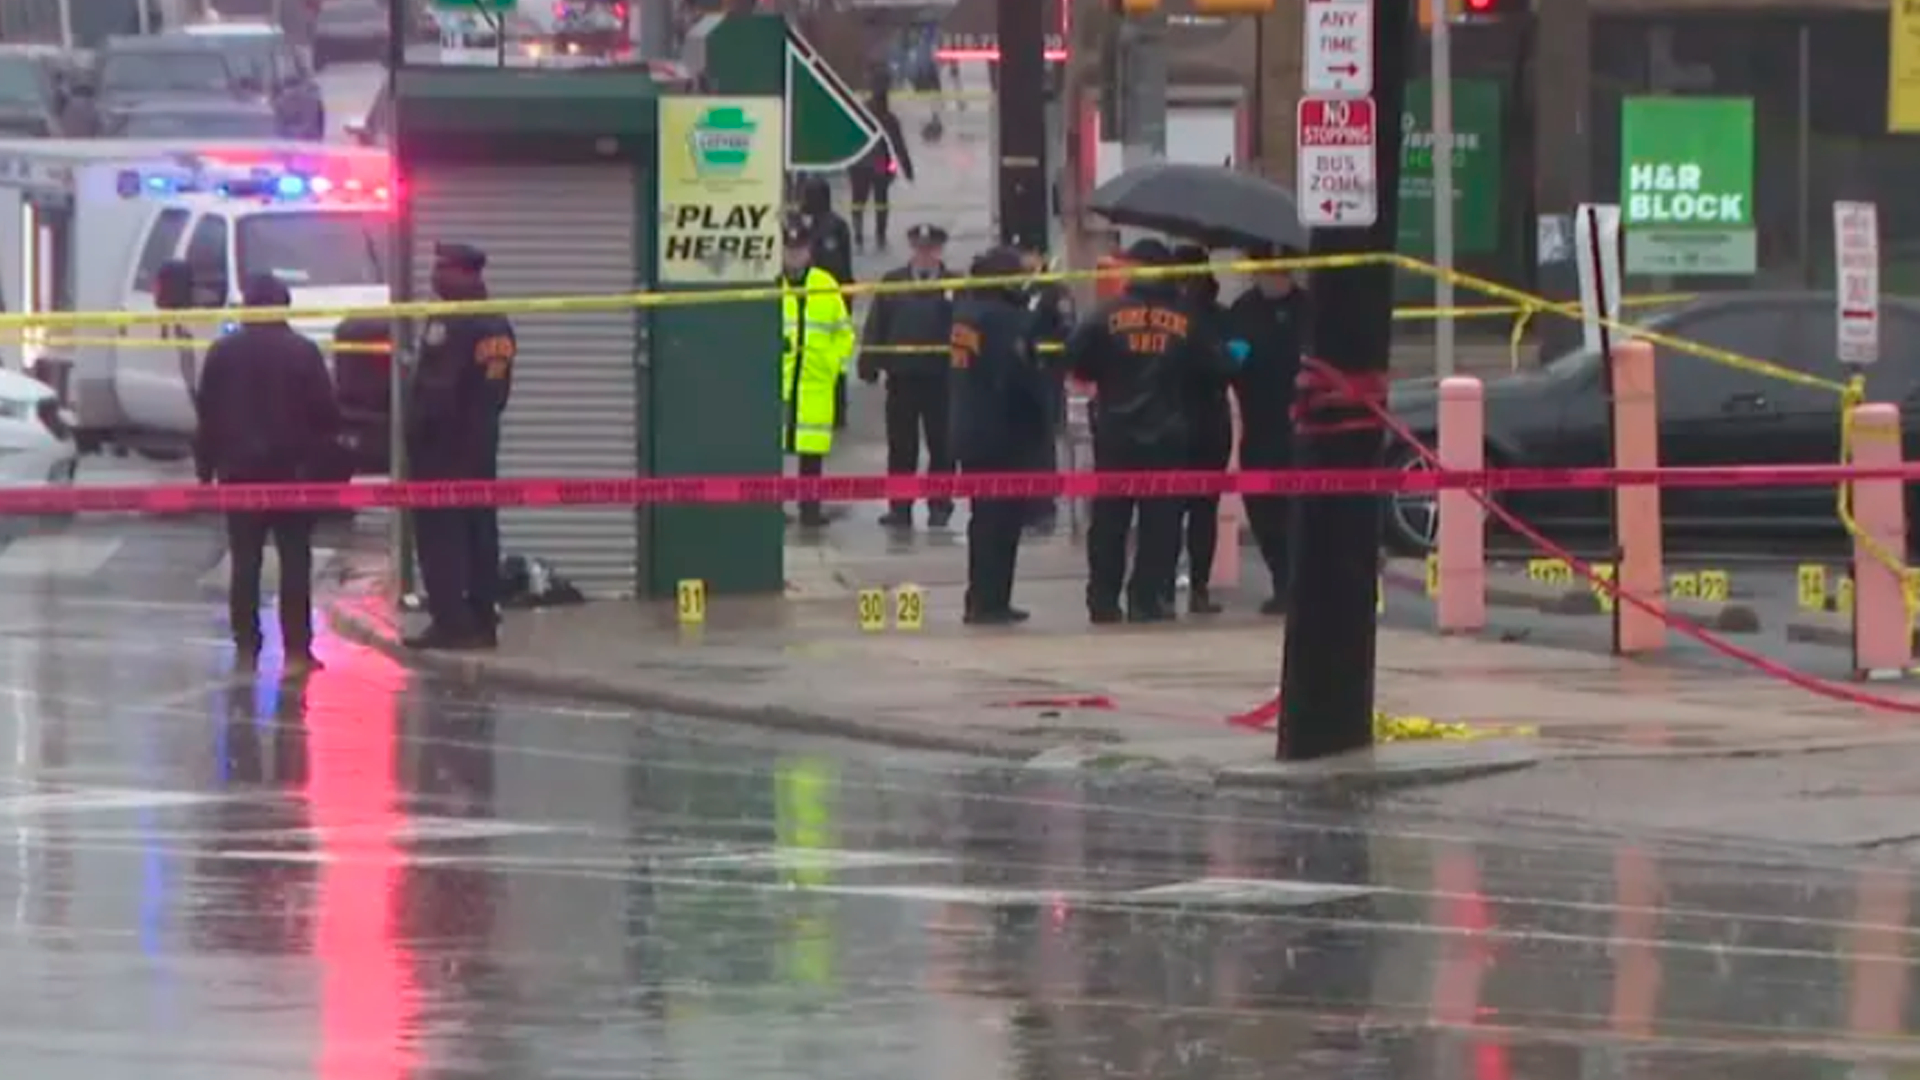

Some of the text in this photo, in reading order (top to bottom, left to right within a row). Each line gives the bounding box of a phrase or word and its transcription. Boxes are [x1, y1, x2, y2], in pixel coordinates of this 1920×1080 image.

[1320, 11, 1357, 28] ANY
[1320, 36, 1357, 53] TIME
[1322, 100, 1350, 126] NO
[1303, 125, 1371, 145] STOPPING
[1316, 155, 1355, 171] BUS
[1310, 174, 1364, 192] ZONE
[1630, 162, 1702, 191] H&R
[676, 204, 770, 230] PLAY
[1630, 192, 1743, 221] BLOCK
[665, 234, 775, 260] HERE!
[682, 586, 701, 613] 31
[861, 593, 882, 622] 30
[899, 592, 921, 621] 29
